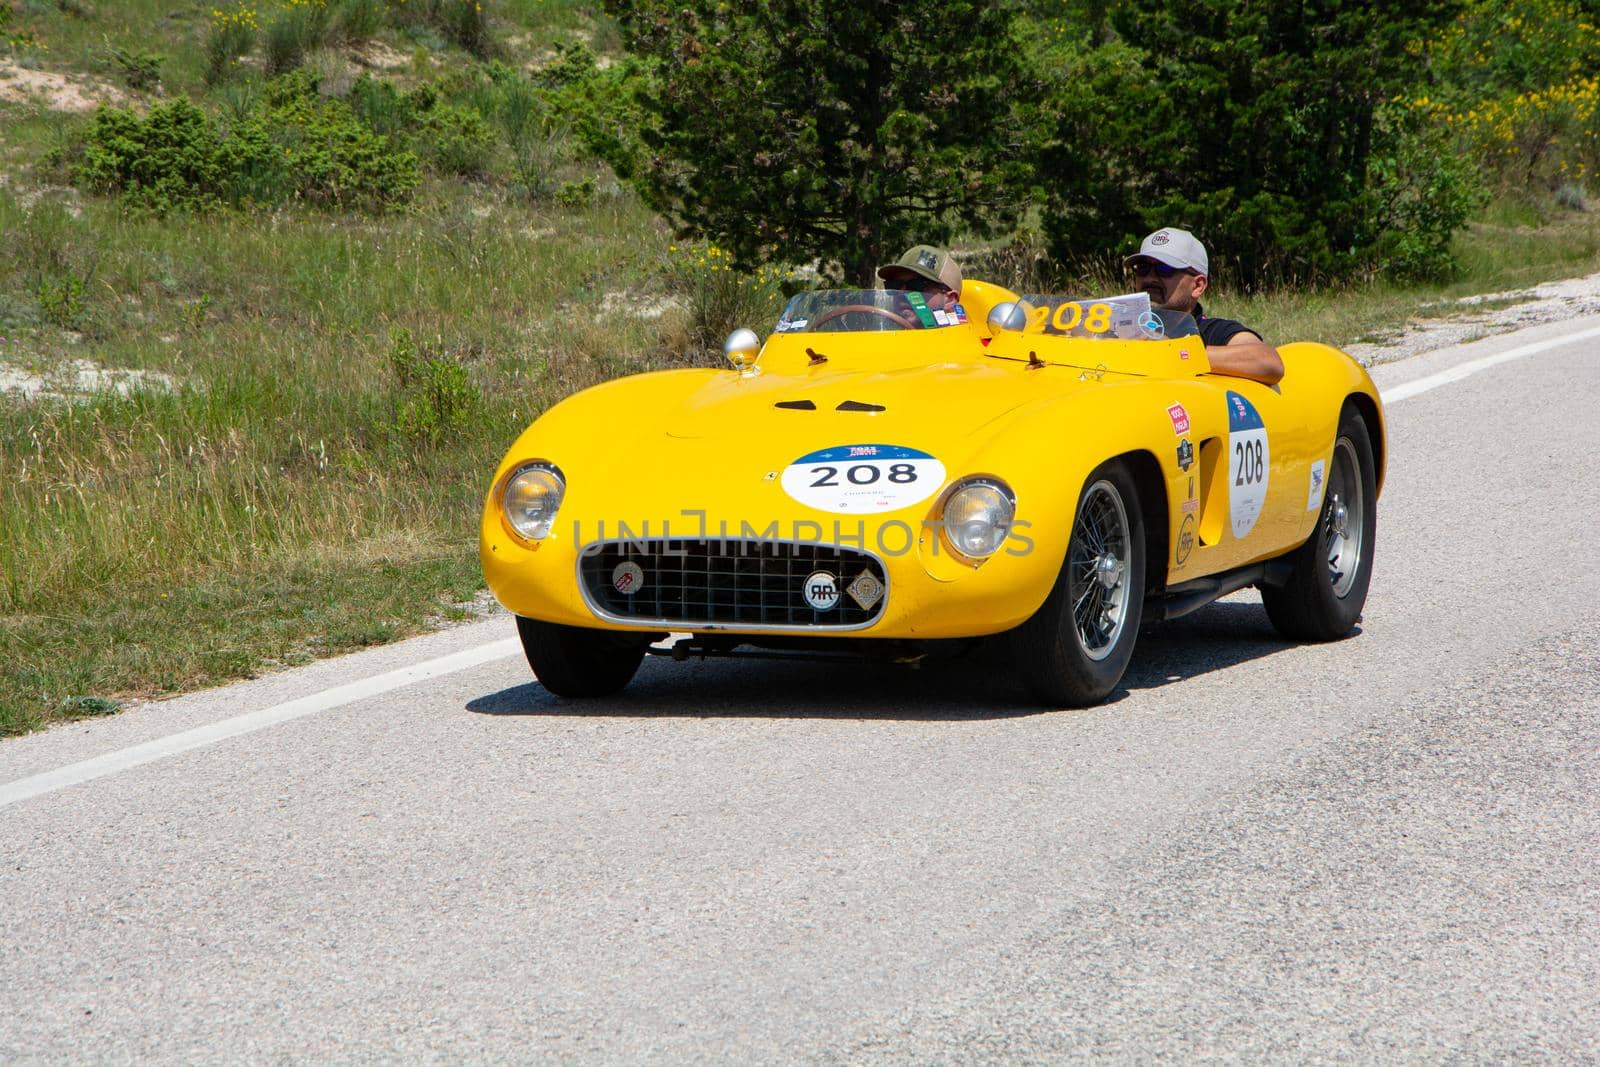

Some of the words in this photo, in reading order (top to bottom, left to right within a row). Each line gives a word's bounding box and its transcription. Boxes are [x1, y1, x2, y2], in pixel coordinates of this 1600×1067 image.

[1023, 302, 1112, 334] 208
[809, 463, 918, 488] 208
[1235, 439, 1263, 487] 208
